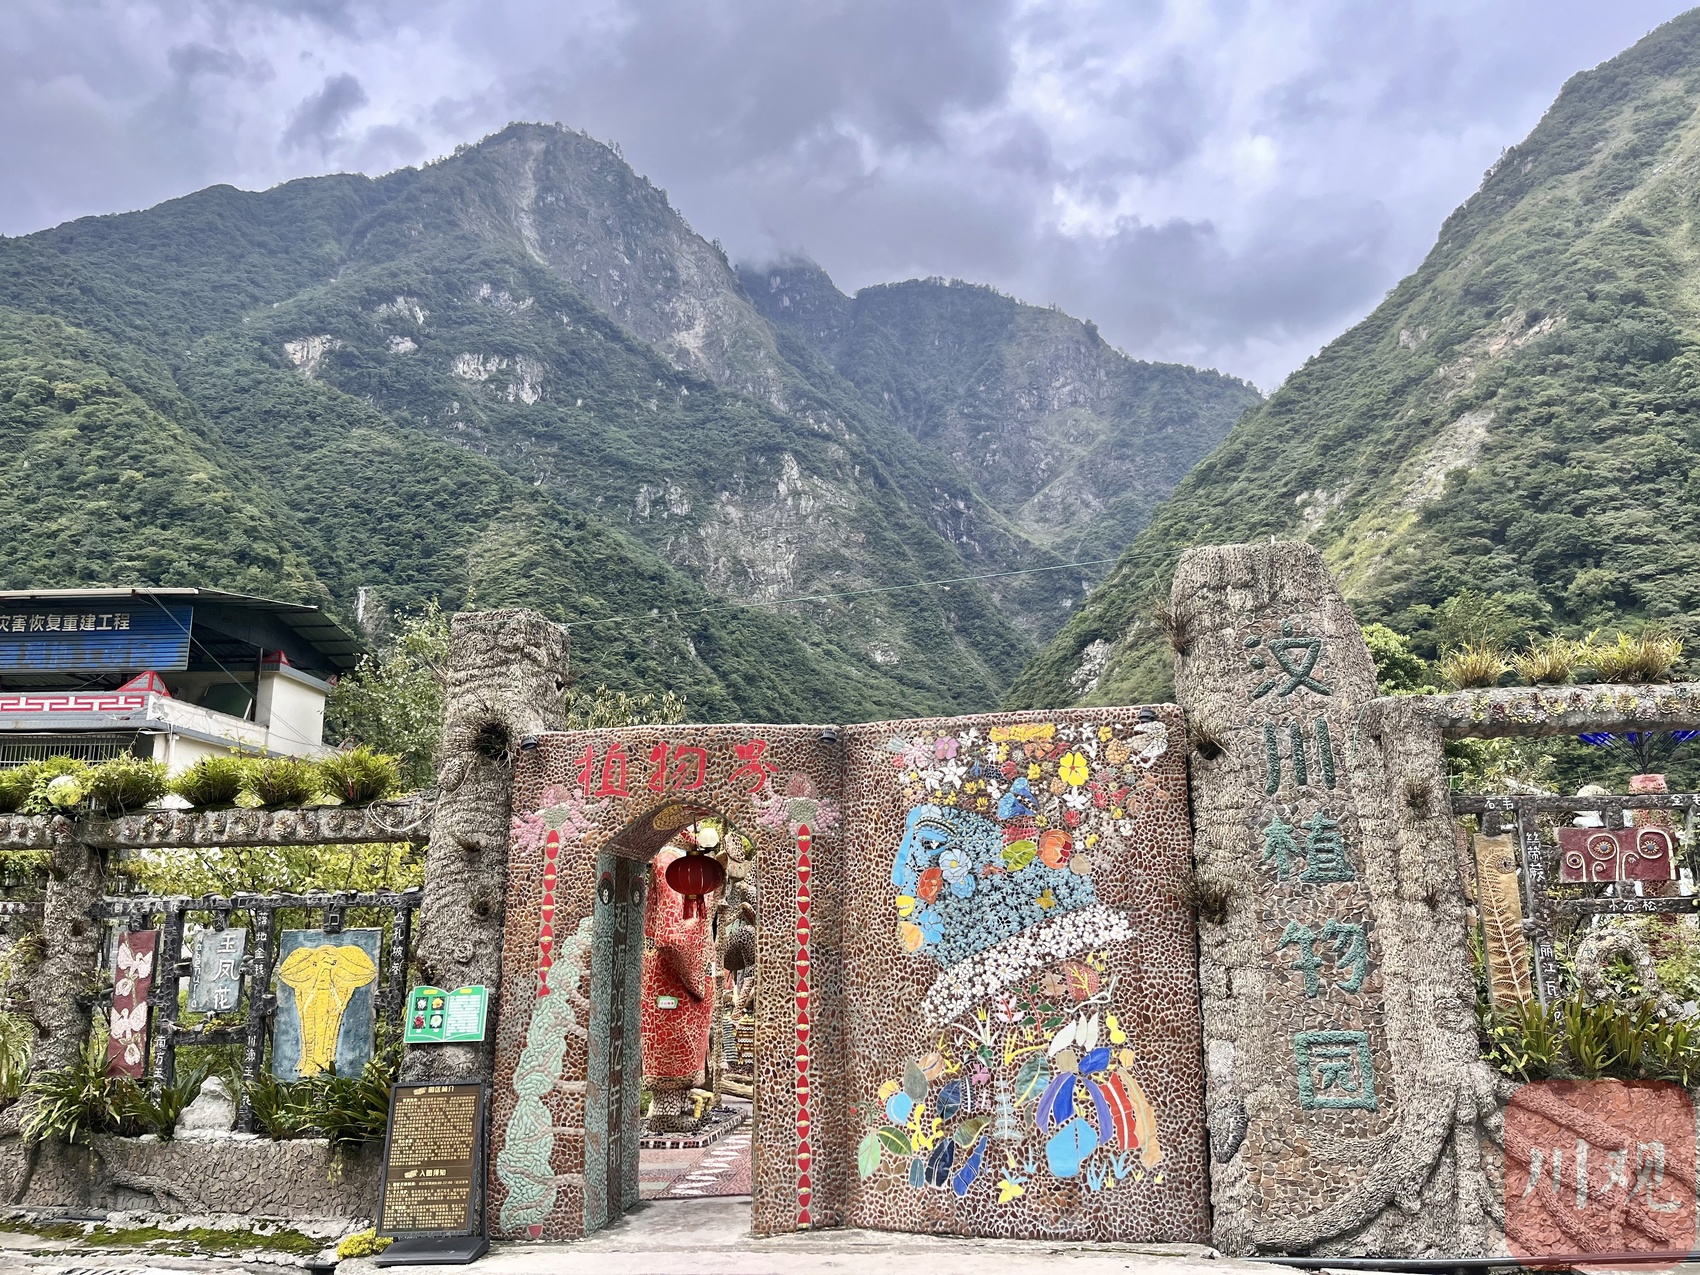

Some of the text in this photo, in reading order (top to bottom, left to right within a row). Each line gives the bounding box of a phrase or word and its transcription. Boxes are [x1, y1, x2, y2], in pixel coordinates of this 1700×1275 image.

[0, 613, 131, 632] 灾害恢复重建工程
[574, 739, 780, 797] 植物界
[1243, 617, 1379, 1113] 汶川植物园
[1608, 899, 1658, 912] 小石松
[213, 933, 240, 1010] 玉凤花
